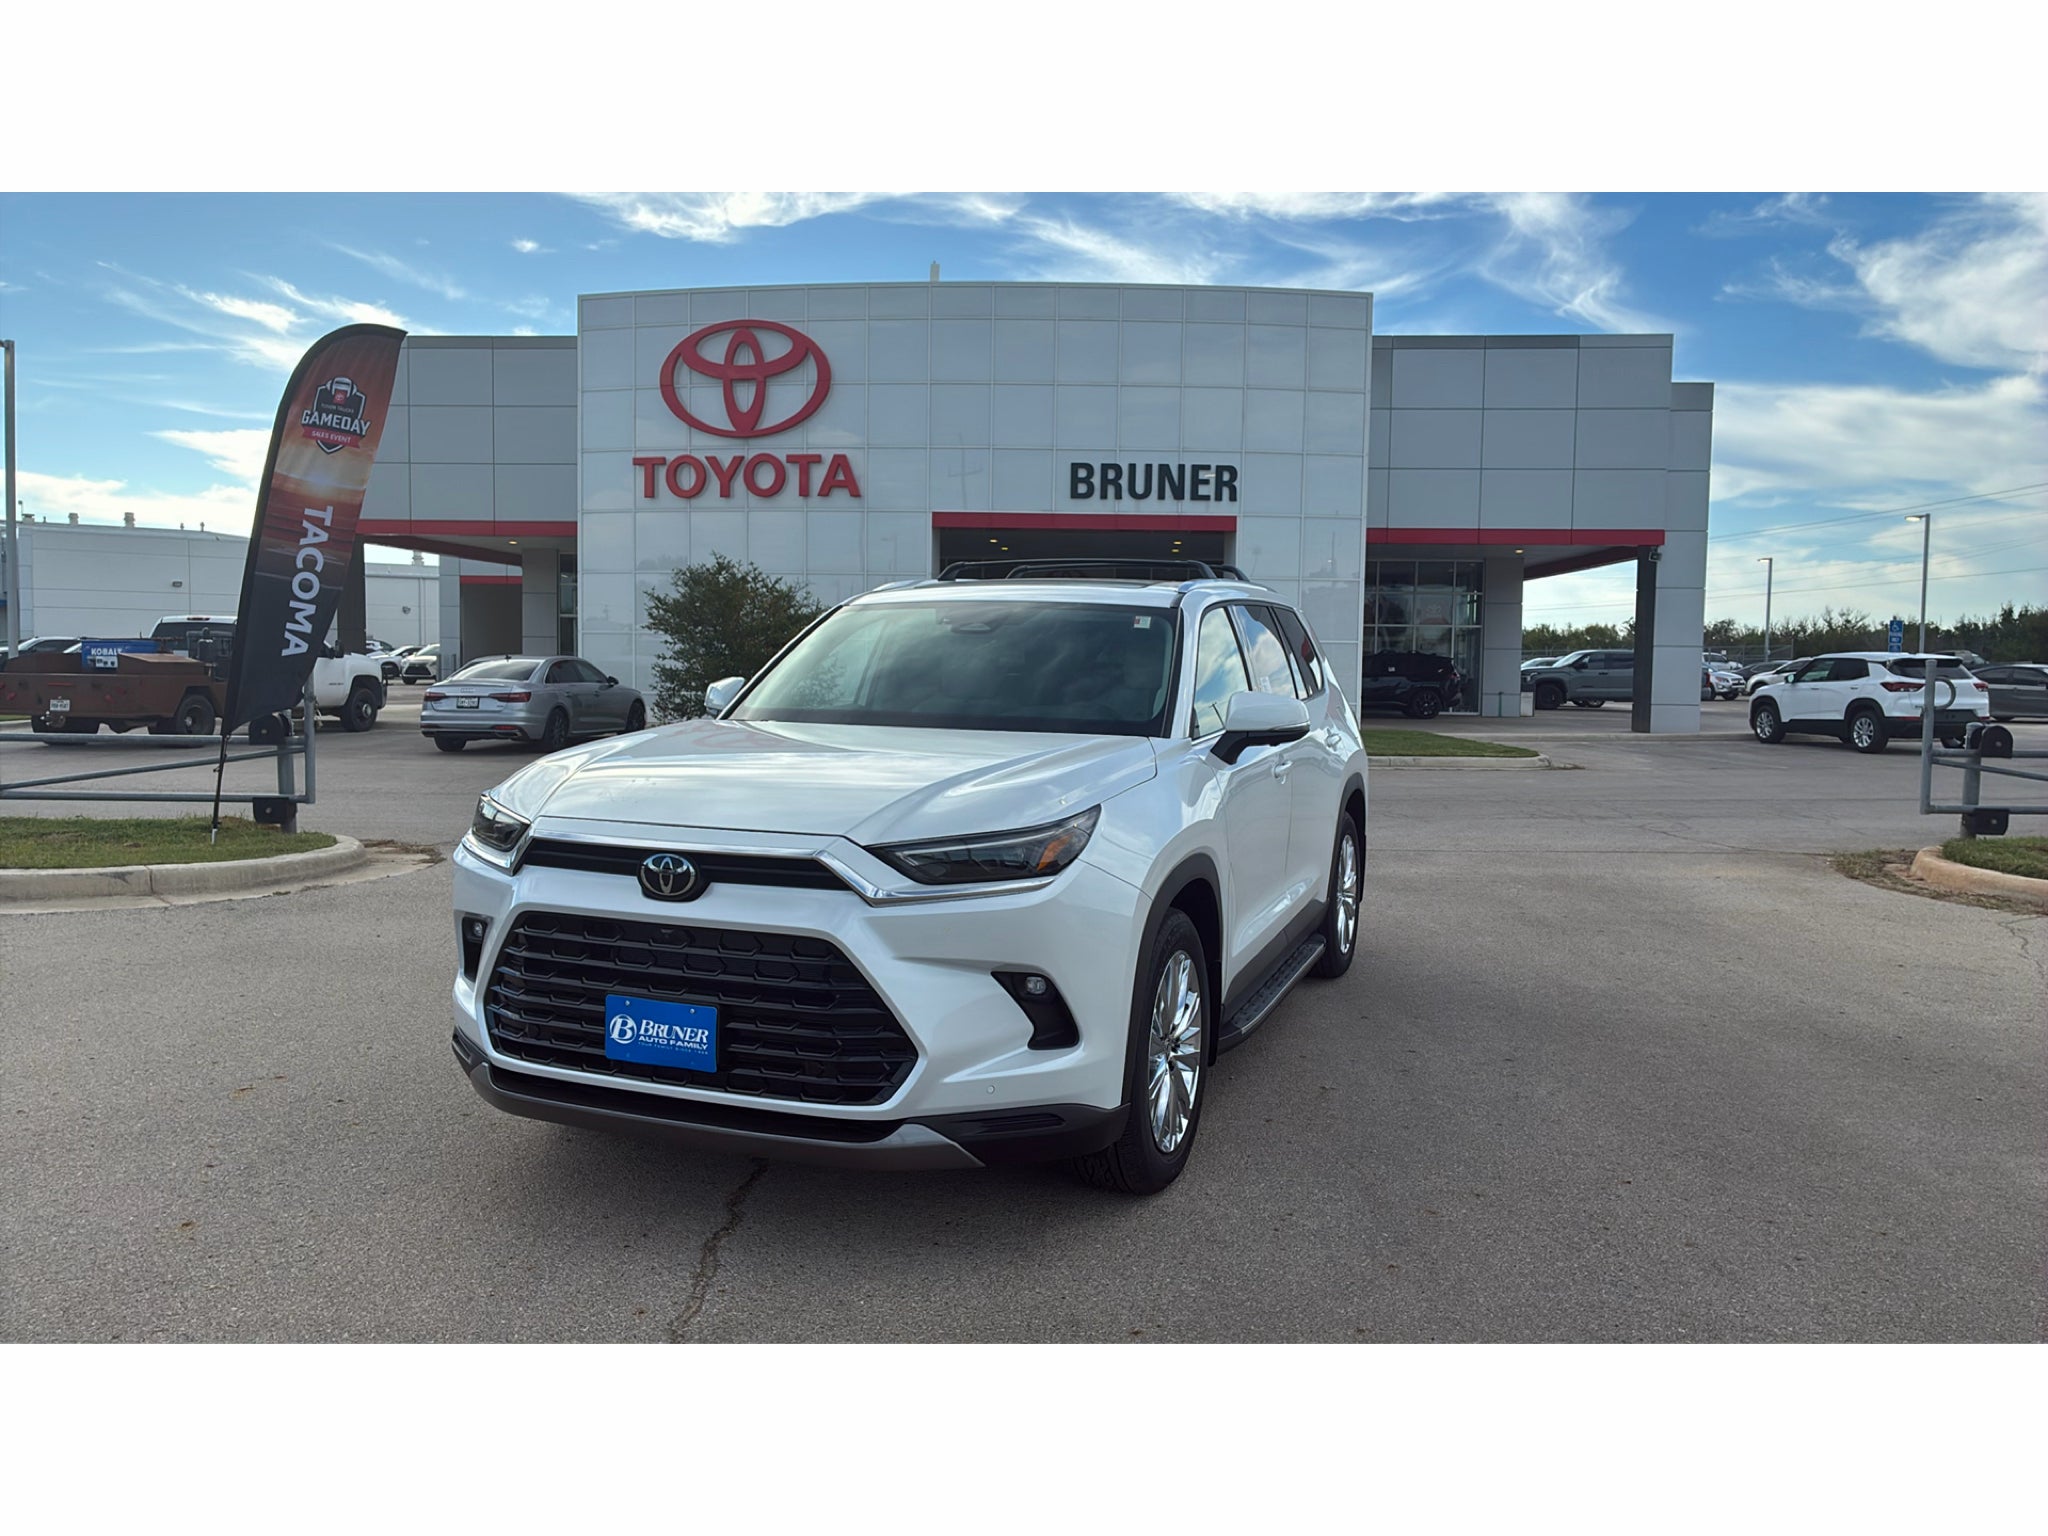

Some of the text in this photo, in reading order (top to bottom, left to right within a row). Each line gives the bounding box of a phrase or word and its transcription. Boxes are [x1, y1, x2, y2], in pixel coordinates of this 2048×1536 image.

[301, 409, 371, 436] GAMEDAY
[311, 430, 351, 444] SALES EVENT
[632, 453, 862, 499] TOYOTA
[1070, 462, 1238, 502] BRUNER
[281, 505, 334, 657] TACOMA
[638, 1035, 708, 1051] AUTO FAMILY
[639, 1019, 709, 1043] BRUNER
